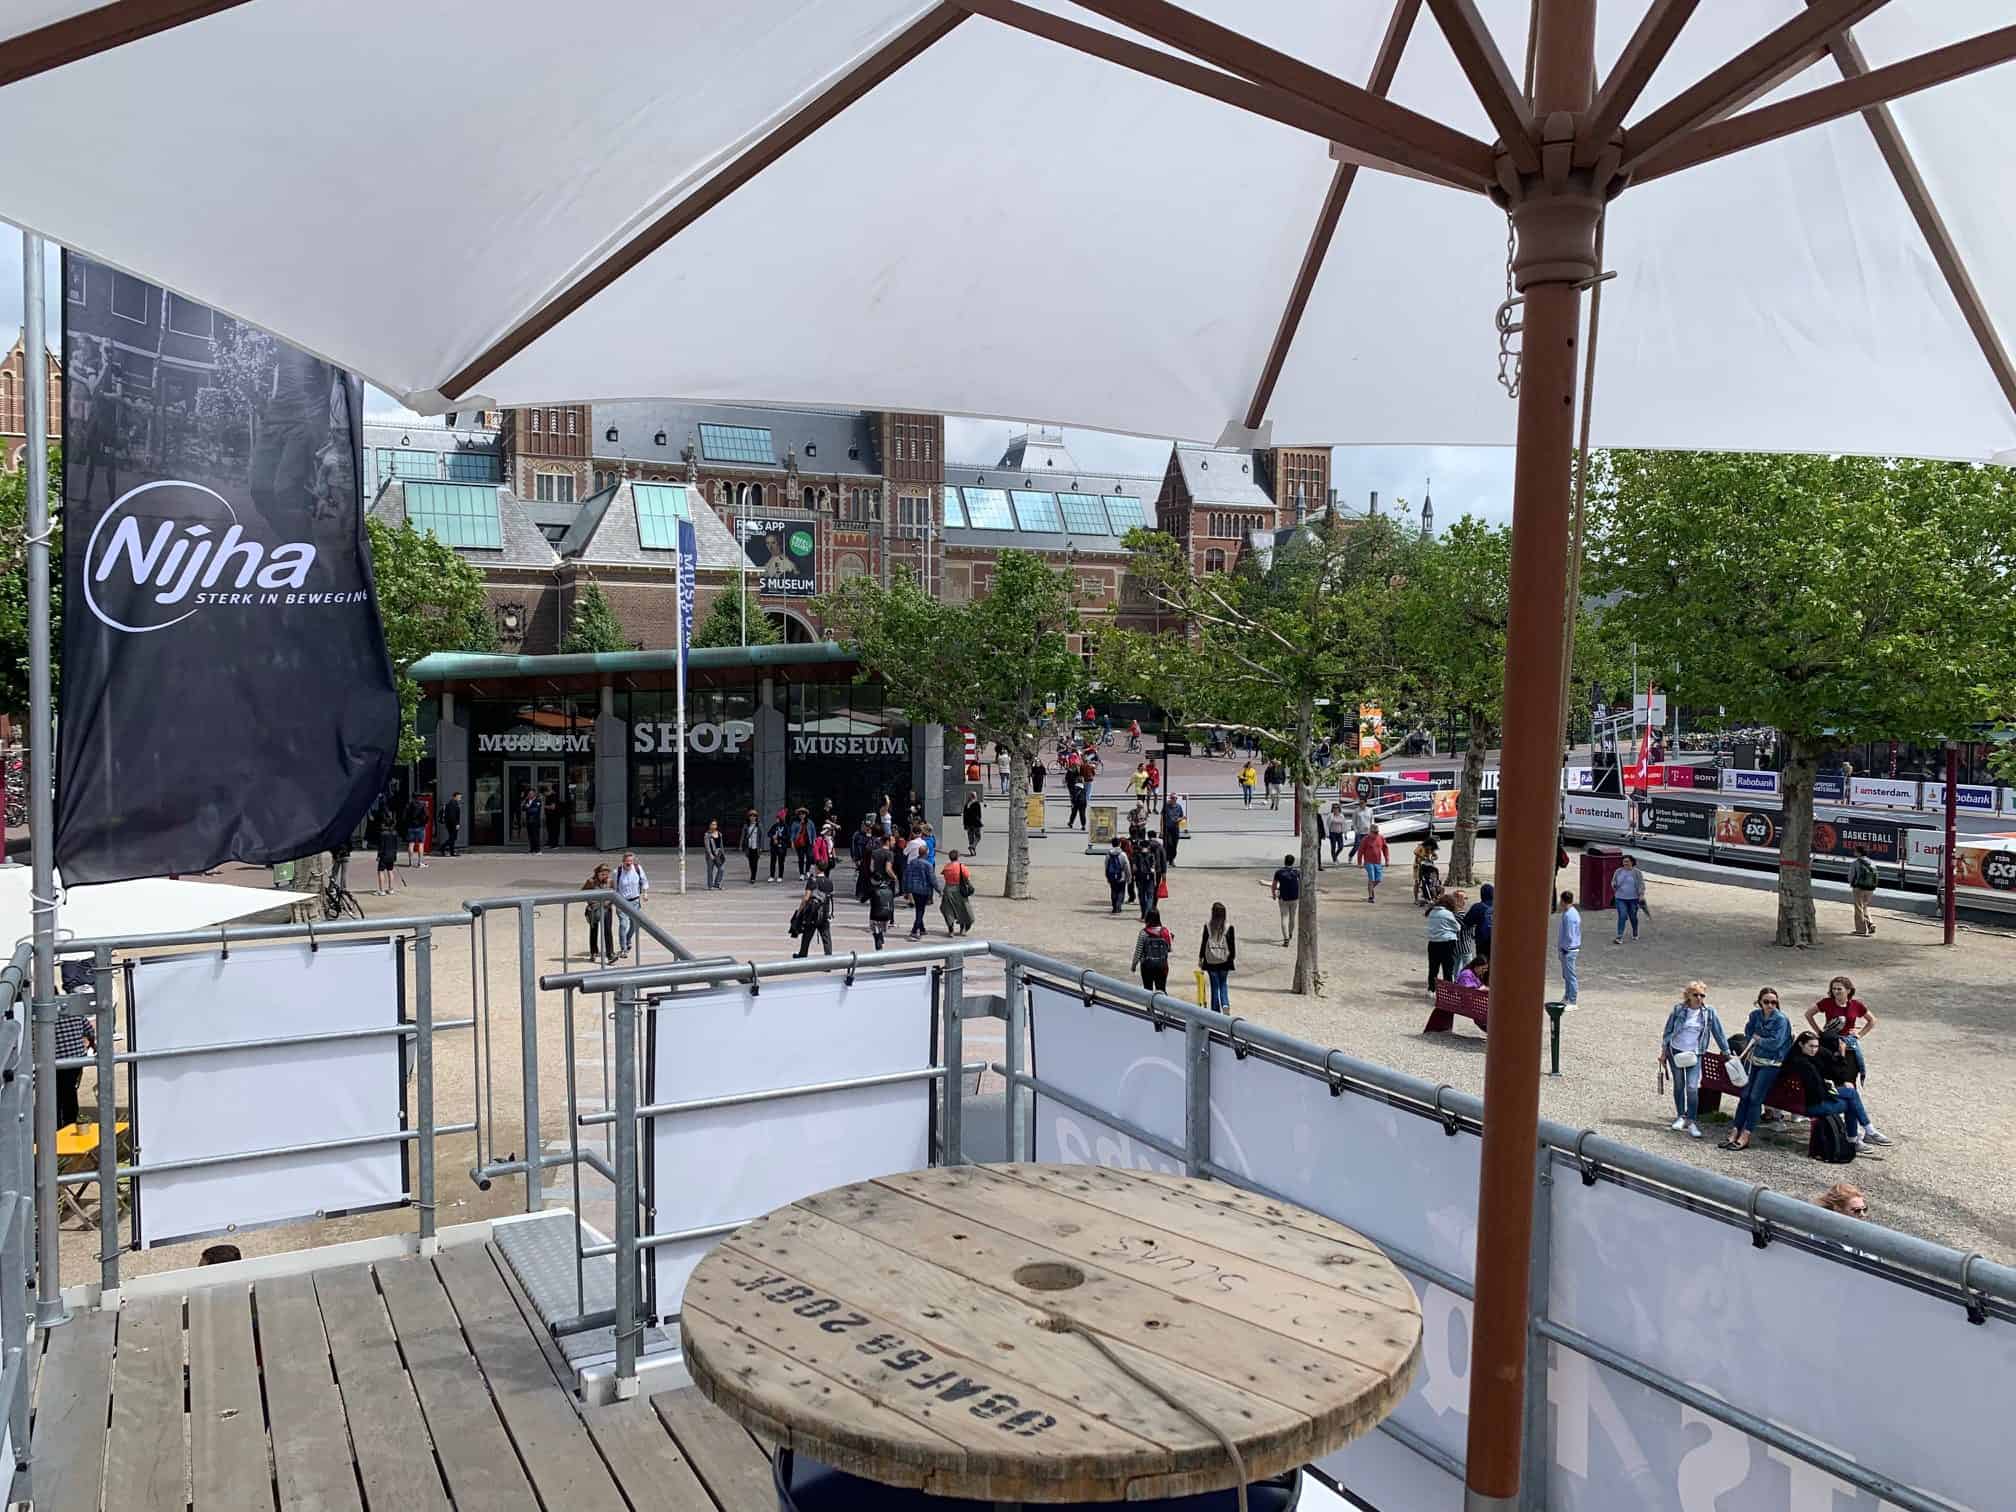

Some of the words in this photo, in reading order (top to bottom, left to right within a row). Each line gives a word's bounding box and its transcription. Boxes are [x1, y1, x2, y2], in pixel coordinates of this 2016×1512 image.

[765, 521, 785, 532] APP
[95, 515, 317, 605] Nijha
[768, 579, 814, 590] MUSEUM
[194, 593, 253, 605] STERK
[259, 594, 279, 604] IN
[478, 734, 591, 752] MUSEUM
[633, 722, 752, 753] SHOP
[793, 736, 905, 755] MUSEUM
[1694, 775, 1717, 784] SONY
[1737, 776, 1774, 789] Rabobank
[1842, 830, 1893, 844] BASKETBALL
